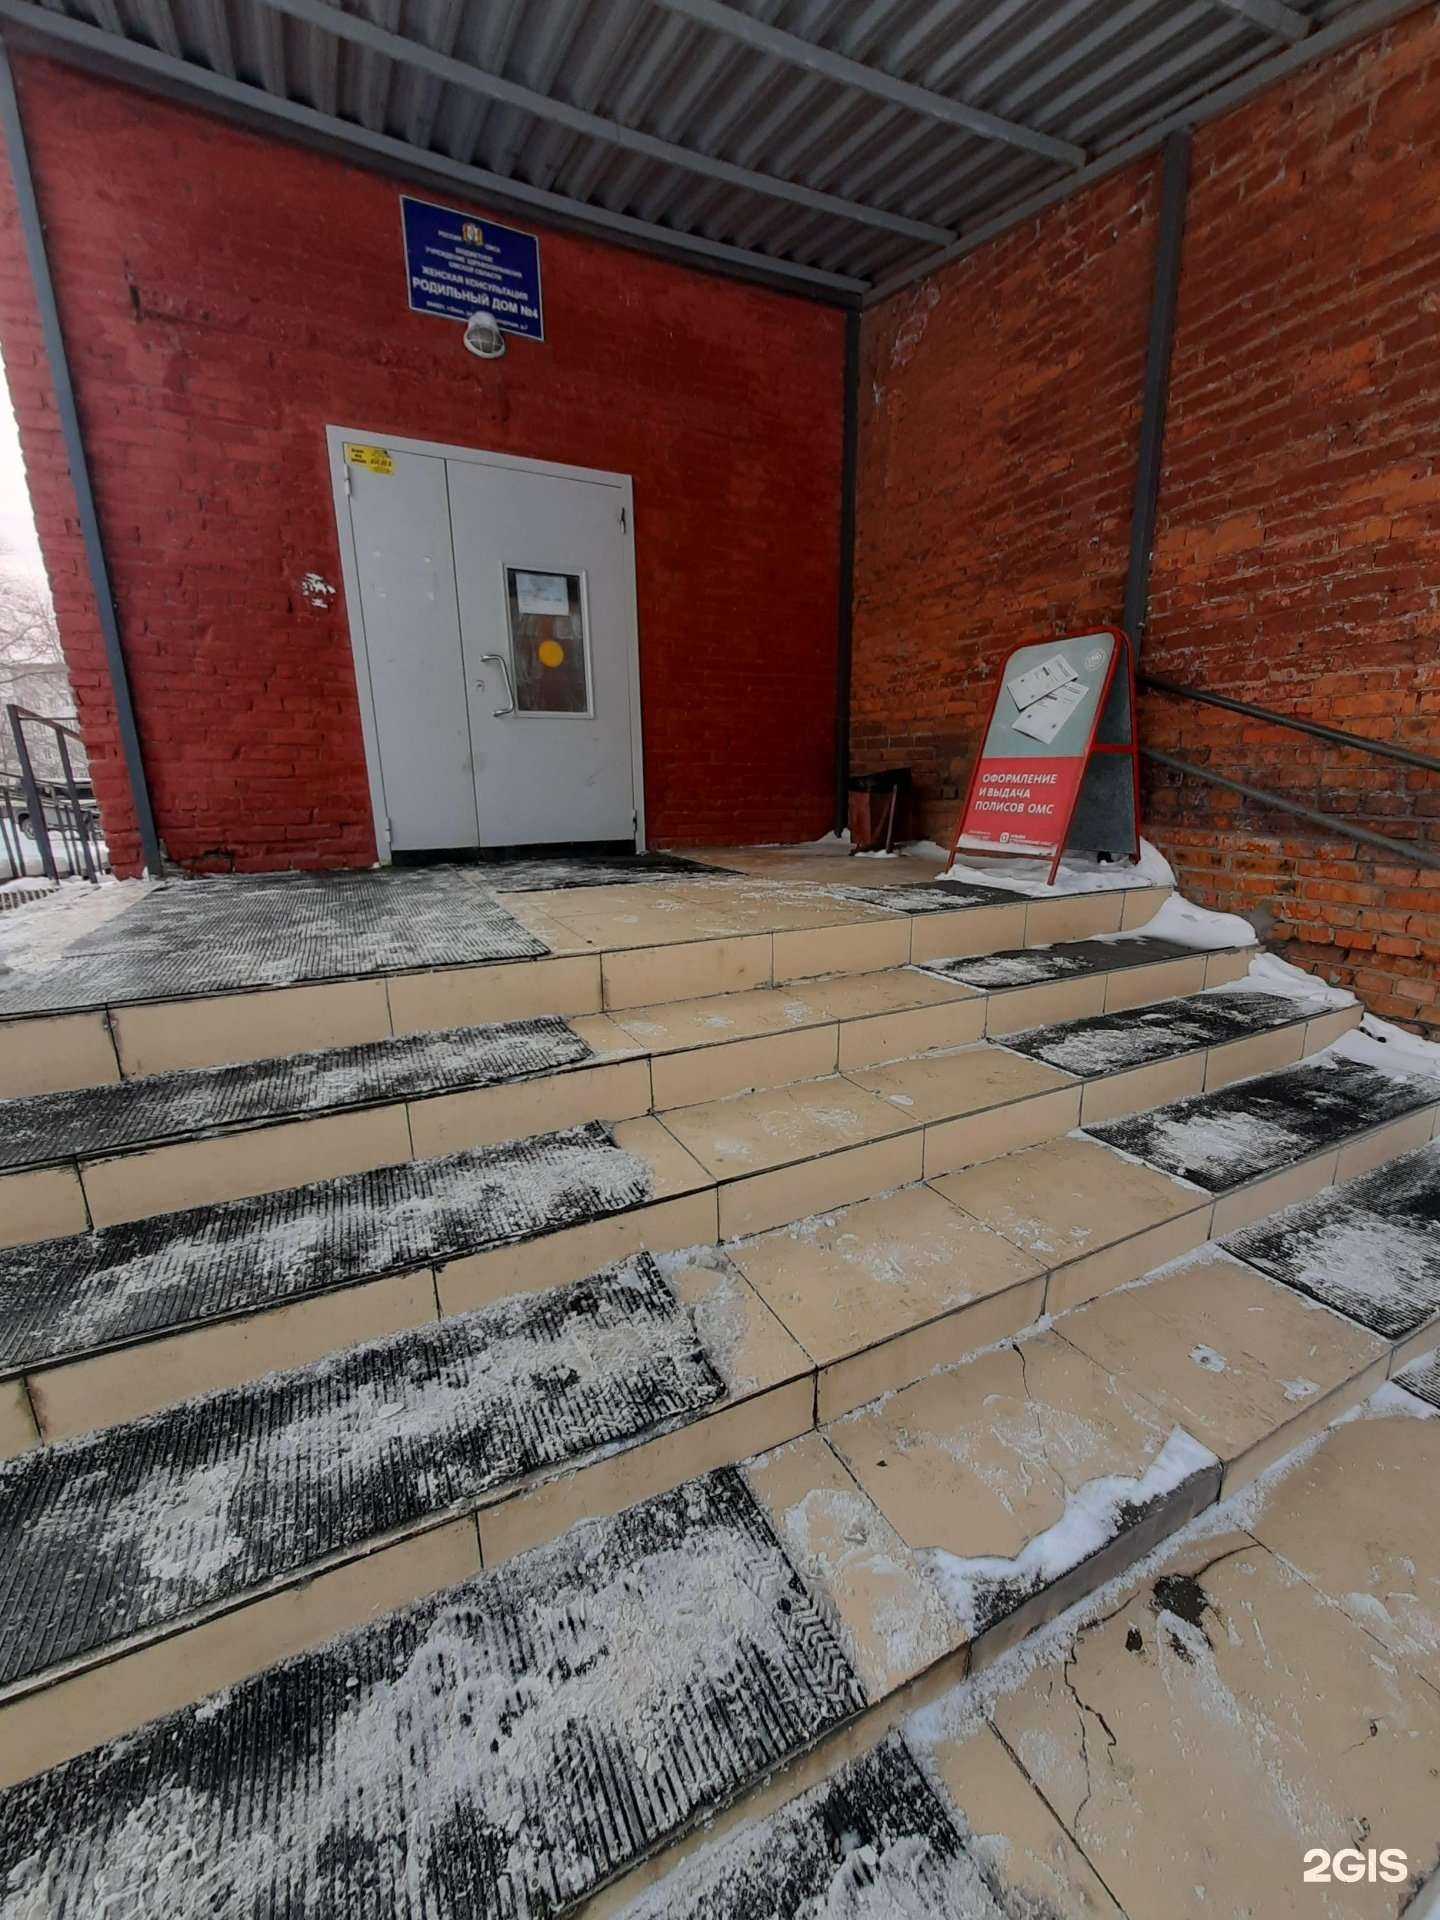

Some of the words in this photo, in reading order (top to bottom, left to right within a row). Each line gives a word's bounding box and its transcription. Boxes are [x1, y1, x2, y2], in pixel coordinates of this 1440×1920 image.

[422, 265, 463, 285] ЖЕНСКАЯ
[465, 277, 528, 301] КОНСУЛЬТАЦИЯ
[412, 276, 490, 306] РОДИЛЬНЫЙ
[492, 298, 518, 314] ДОМ
[520, 305, 539, 319] №4
[982, 773, 1058, 784] ОФОРМЛЕНИЕ
[987, 787, 1031, 799] ВЫДАЧА
[975, 801, 1024, 812] ПОЛИСОВ
[1028, 803, 1055, 815] ОМС
